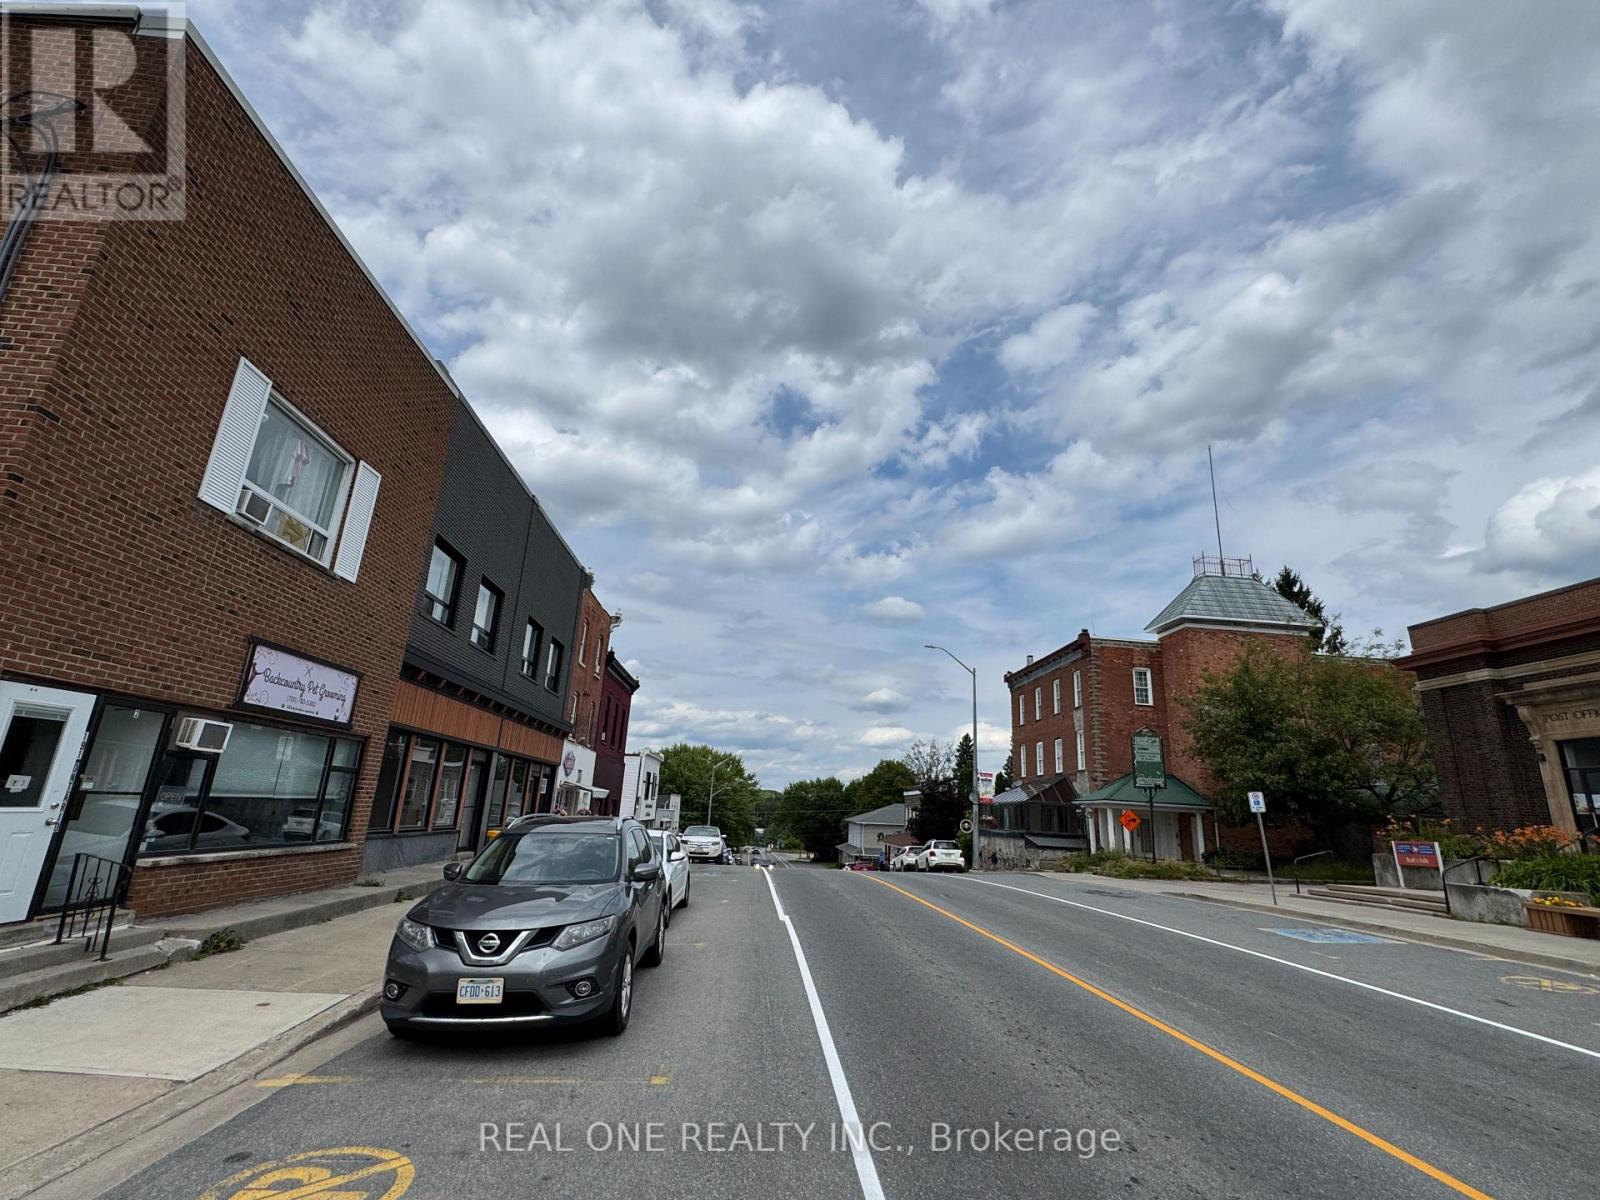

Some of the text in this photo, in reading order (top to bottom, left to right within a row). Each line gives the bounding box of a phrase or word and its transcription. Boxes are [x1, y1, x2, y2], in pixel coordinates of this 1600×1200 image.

[263, 668, 346, 707] Backcountry Pet Grooming
[1544, 708, 1600, 722] POST OFFI
[160, 791, 183, 802] OPEN
